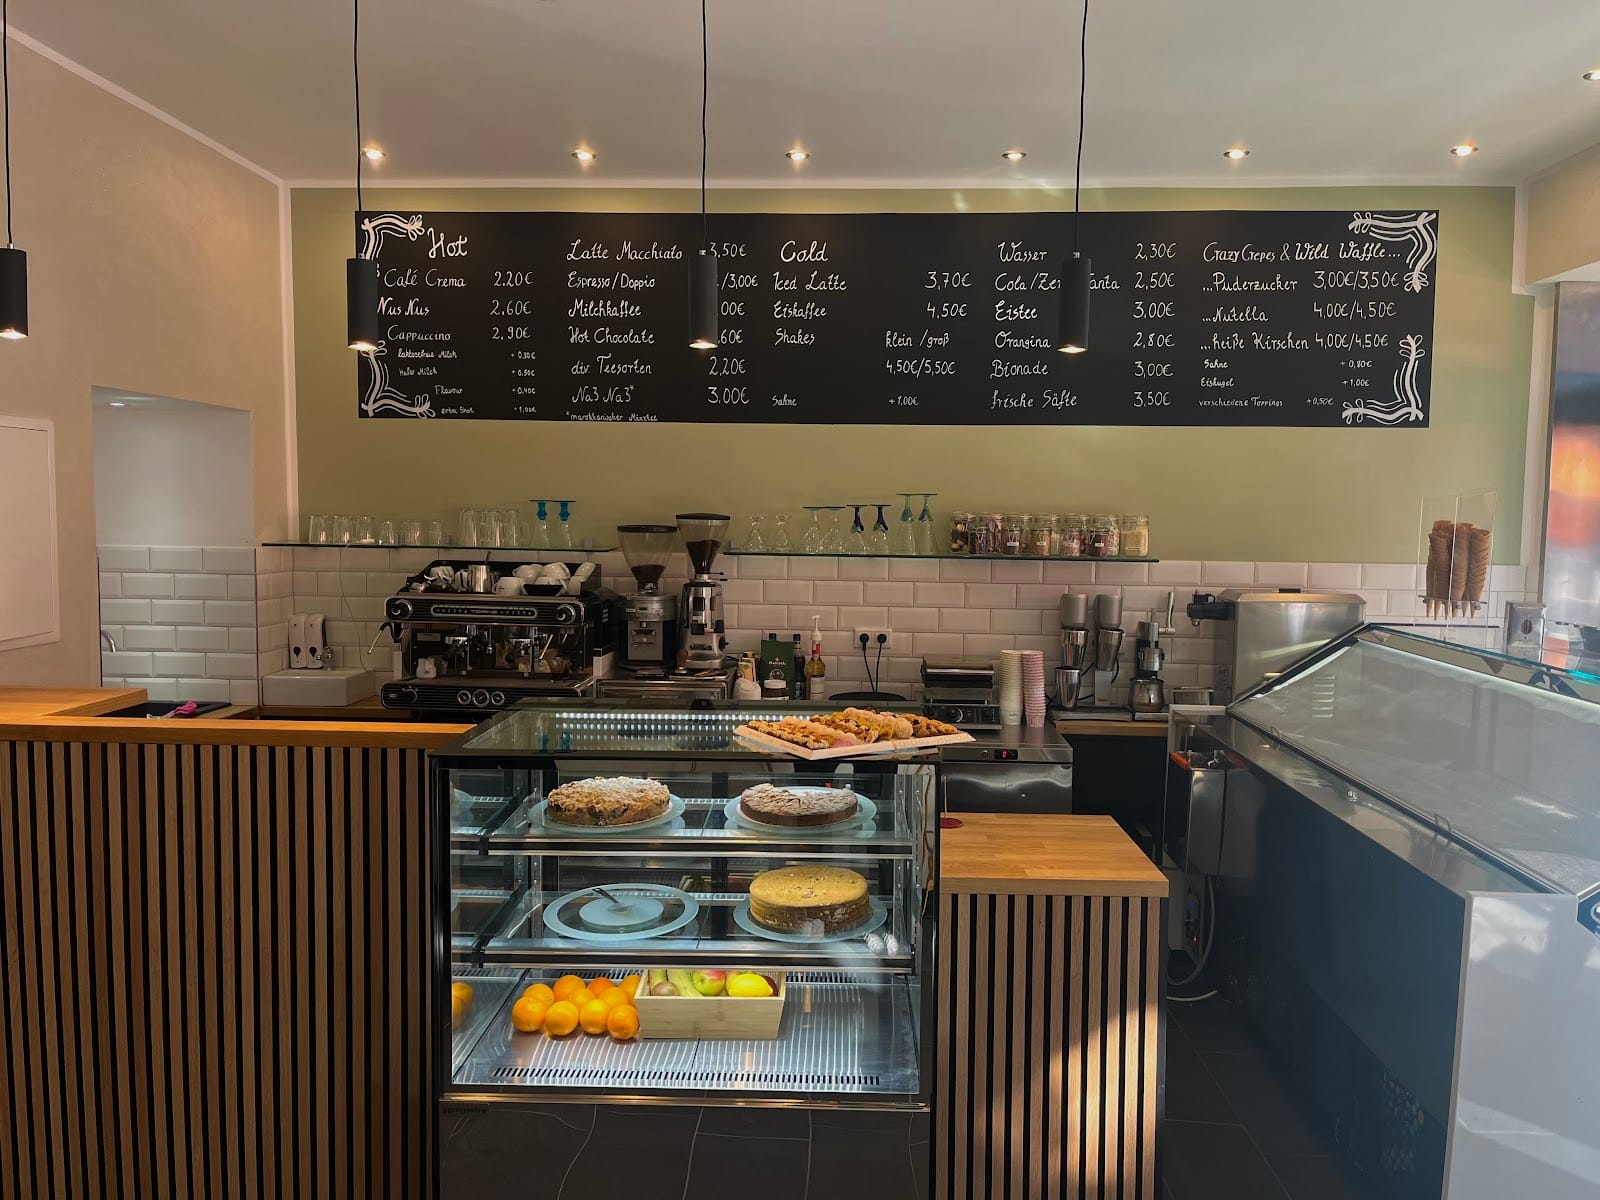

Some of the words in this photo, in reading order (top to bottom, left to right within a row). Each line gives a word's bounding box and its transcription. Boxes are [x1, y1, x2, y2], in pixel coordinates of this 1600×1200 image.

[427, 228, 467, 258] Hot
[567, 239, 608, 260] Latte
[616, 241, 682, 260] Macchiato
[781, 241, 828, 262] Cold
[998, 241, 1047, 262] Wasser
[1135, 243, 1176, 261] 2,30€
[1203, 242, 1240, 262] Crazy
[1242, 244, 1275, 262] Crepes
[1280, 243, 1290, 261] &
[1295, 243, 1329, 260] Wild
[426, 269, 467, 287] Crema
[568, 271, 655, 290] Espresso/Doppio
[773, 272, 797, 290] Iced
[805, 271, 847, 290] Latte
[925, 272, 971, 290] 3,70€
[1135, 272, 1175, 290] 2,50€
[377, 297, 401, 315] Nus
[405, 298, 429, 316] Nus
[568, 298, 641, 317] Milchkaffee
[774, 301, 826, 319] Eiskaffee
[995, 300, 1037, 321] Eistee
[388, 325, 451, 341] Cappuccino
[568, 326, 590, 343] Hot
[594, 328, 654, 344] Chocolate
[775, 328, 814, 345] Shakes
[886, 331, 912, 347] klein
[995, 331, 1051, 349] Orangina
[1133, 332, 1174, 348] 2,80€
[1252, 332, 1309, 350] Kirschen
[438, 350, 457, 358] Milch
[1204, 359, 1228, 368] Sahne
[418, 367, 437, 375] Milch
[597, 353, 652, 375] Teesorten
[886, 358, 955, 378] 4,50€/5,50€
[990, 360, 1048, 379] Bionade
[1135, 361, 1173, 378] 3,00€
[1201, 377, 1234, 388] Eiskugel
[772, 394, 797, 406] Sahne
[991, 390, 1033, 409] frische
[1042, 390, 1077, 409] Säfte
[1251, 396, 1282, 407] Toppings
